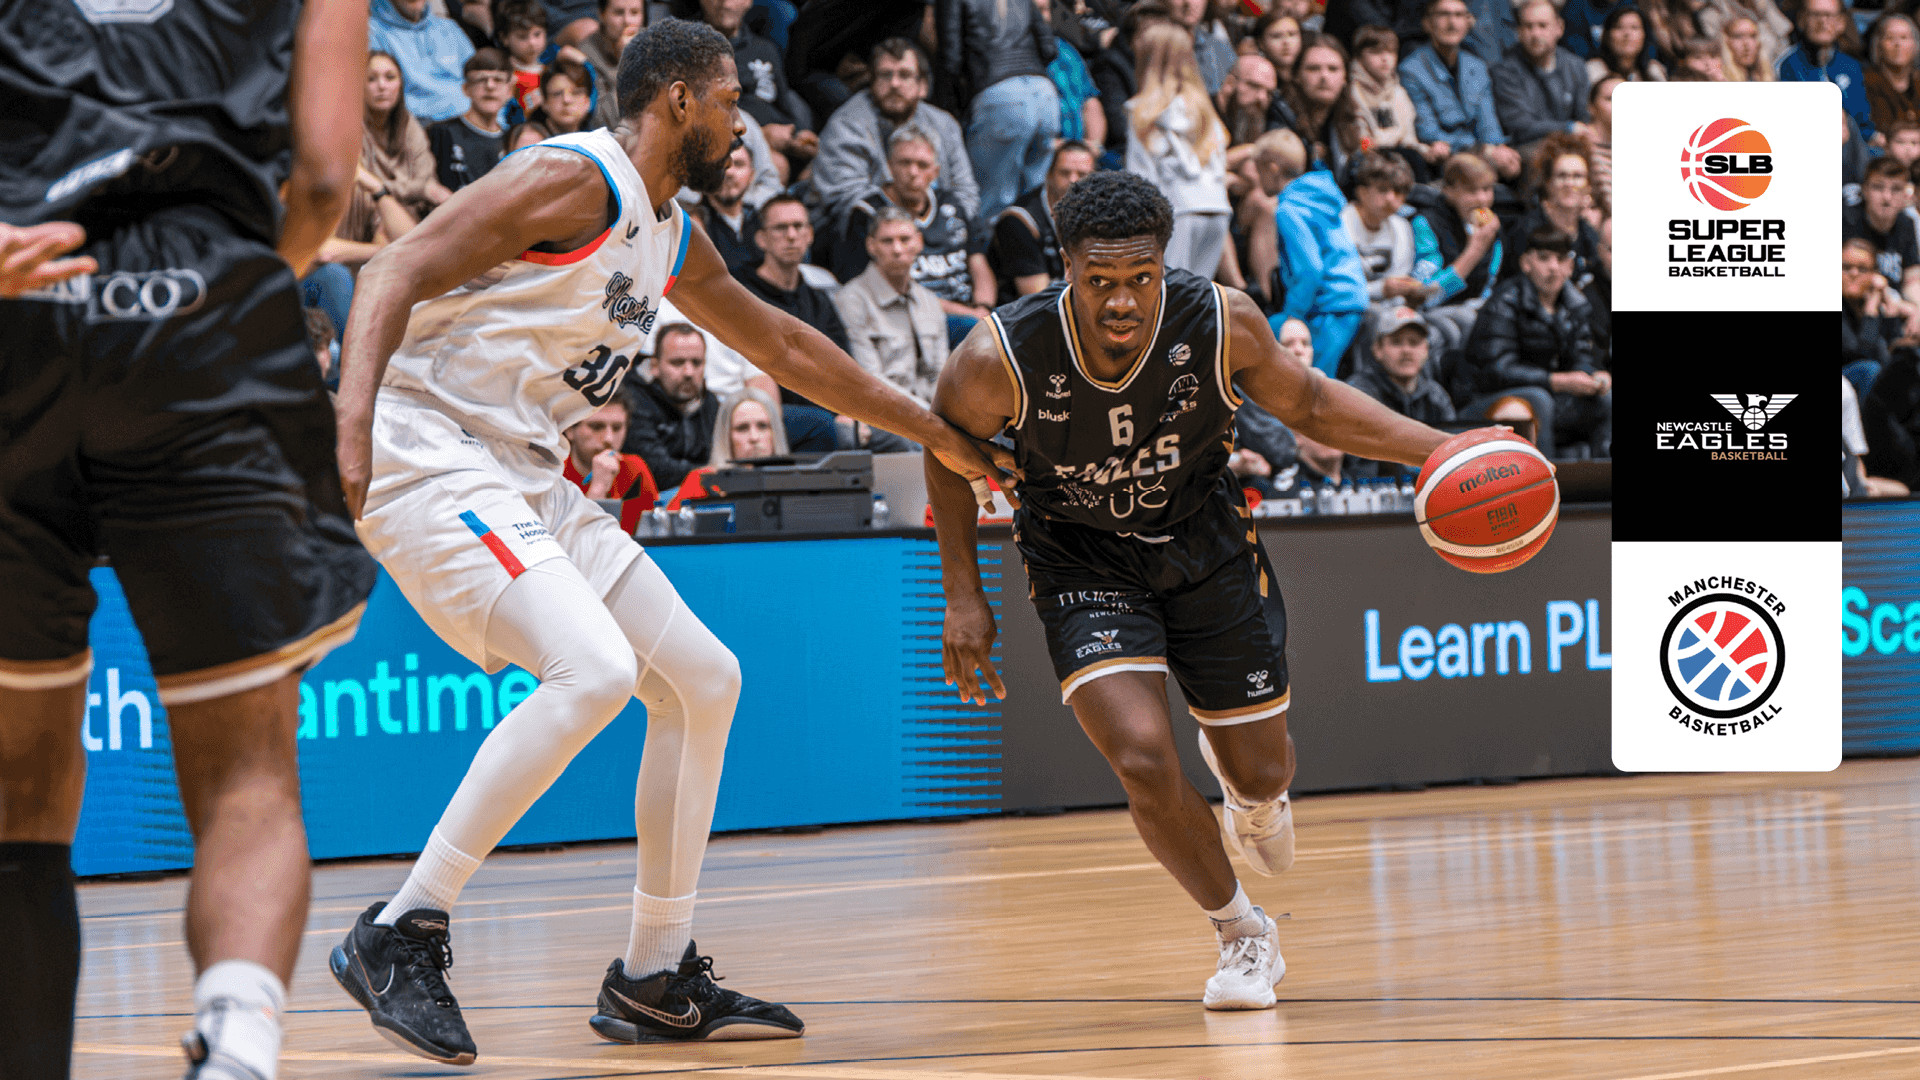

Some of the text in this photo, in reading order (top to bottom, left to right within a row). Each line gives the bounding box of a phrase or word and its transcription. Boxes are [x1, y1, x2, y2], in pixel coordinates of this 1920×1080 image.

[562, 344, 630, 407] 30
[1108, 403, 1134, 447] 6
[1459, 463, 1521, 494] molten
[1486, 502, 1518, 525] FIBA
[1076, 642, 1122, 659] EAGLES
[1364, 599, 1612, 682] Learn PL
